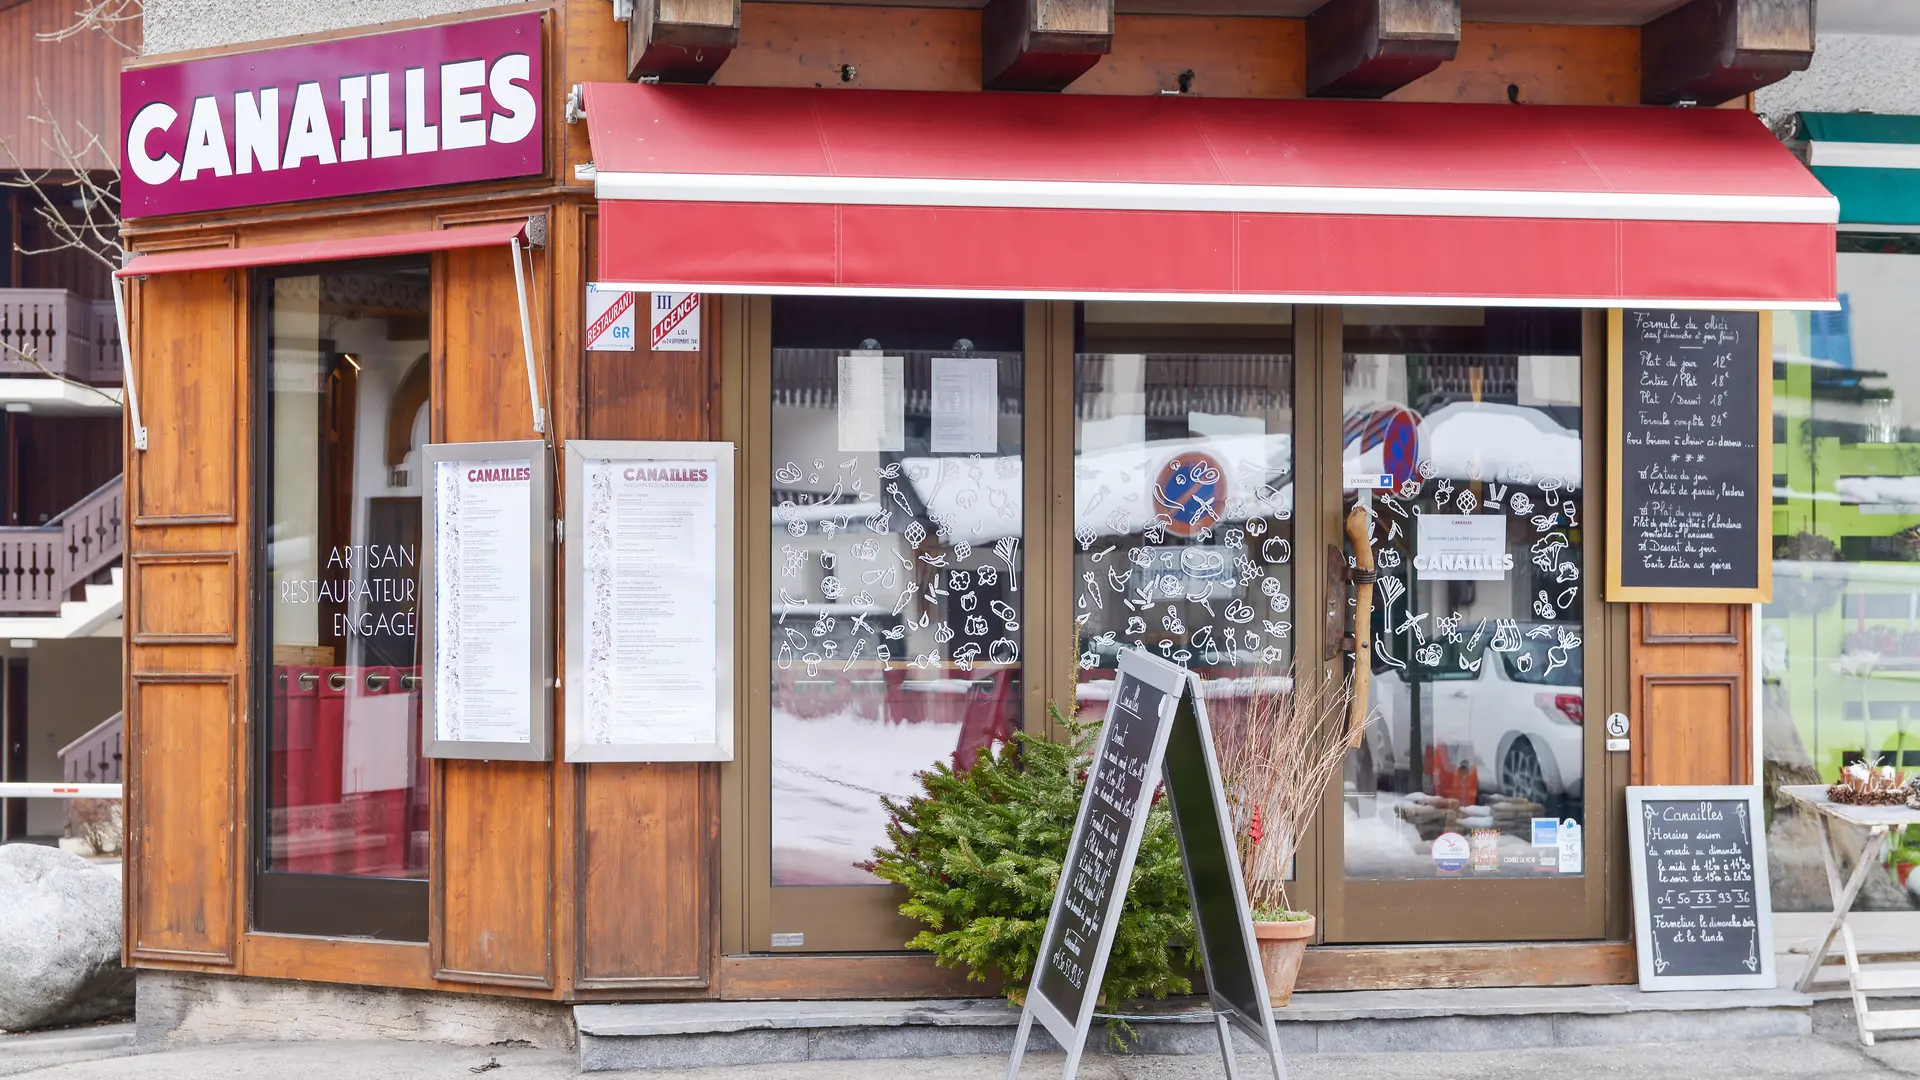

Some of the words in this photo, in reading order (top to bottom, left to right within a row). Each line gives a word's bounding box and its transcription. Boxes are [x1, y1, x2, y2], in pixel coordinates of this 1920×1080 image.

[127, 52, 537, 185] CANAILLES
[657, 295, 672, 310] III
[652, 292, 698, 343] LICENCE
[1633, 311, 1680, 329] Formule
[1685, 316, 1698, 329] du
[613, 326, 630, 339] GR
[1639, 351, 1662, 366] Plat
[1666, 356, 1677, 367] du
[1680, 357, 1698, 373] jour
[1640, 370, 1669, 387] Entrée
[1680, 373, 1698, 387] Plat
[1640, 390, 1660, 404] Plat
[1638, 411, 1670, 426] Formule
[468, 467, 531, 483] CANAILLES
[623, 468, 708, 481] CANAILLES
[1350, 477, 1373, 485] poussez
[1680, 470, 1690, 480] du
[1678, 484, 1688, 496] de
[1652, 501, 1673, 517] Plat
[1675, 505, 1685, 517] du
[1632, 516, 1649, 528] Filet
[1649, 539, 1684, 552] Dessert
[1685, 541, 1696, 552] du
[327, 544, 414, 569] ARTISAN
[1413, 553, 1514, 572] CANAILLES
[1642, 554, 1665, 569] Tarte
[1668, 556, 1691, 569] tatin
[281, 578, 415, 604] RESTAURATEUR
[334, 607, 415, 637] ENGAGÉ
[1662, 802, 1723, 822] Canailles
[1652, 828, 1688, 840] Horaires
[1696, 830, 1721, 840] saison
[1649, 847, 1659, 856] du
[1664, 844, 1690, 856] mardi
[1708, 843, 1742, 855] dimanche
[1657, 859, 1667, 871] le
[1669, 861, 1687, 871] midi
[1691, 859, 1701, 871] de
[1723, 859, 1730, 870] à
[1659, 870, 1669, 882] le
[1669, 873, 1689, 882] soir
[1693, 872, 1704, 882] de
[1724, 871, 1732, 881] à
[1657, 890, 1671, 904] 04
[1677, 892, 1690, 904] 50
[1696, 892, 1712, 904] 53
[1718, 892, 1732, 903] 93
[1737, 892, 1750, 903] 36
[1653, 914, 1696, 928] Fermeture
[1699, 914, 1708, 928] le
[1709, 914, 1741, 928] dimanche
[1673, 931, 1684, 943] et
[1686, 930, 1696, 942] le
[1700, 930, 1724, 942] lundi
